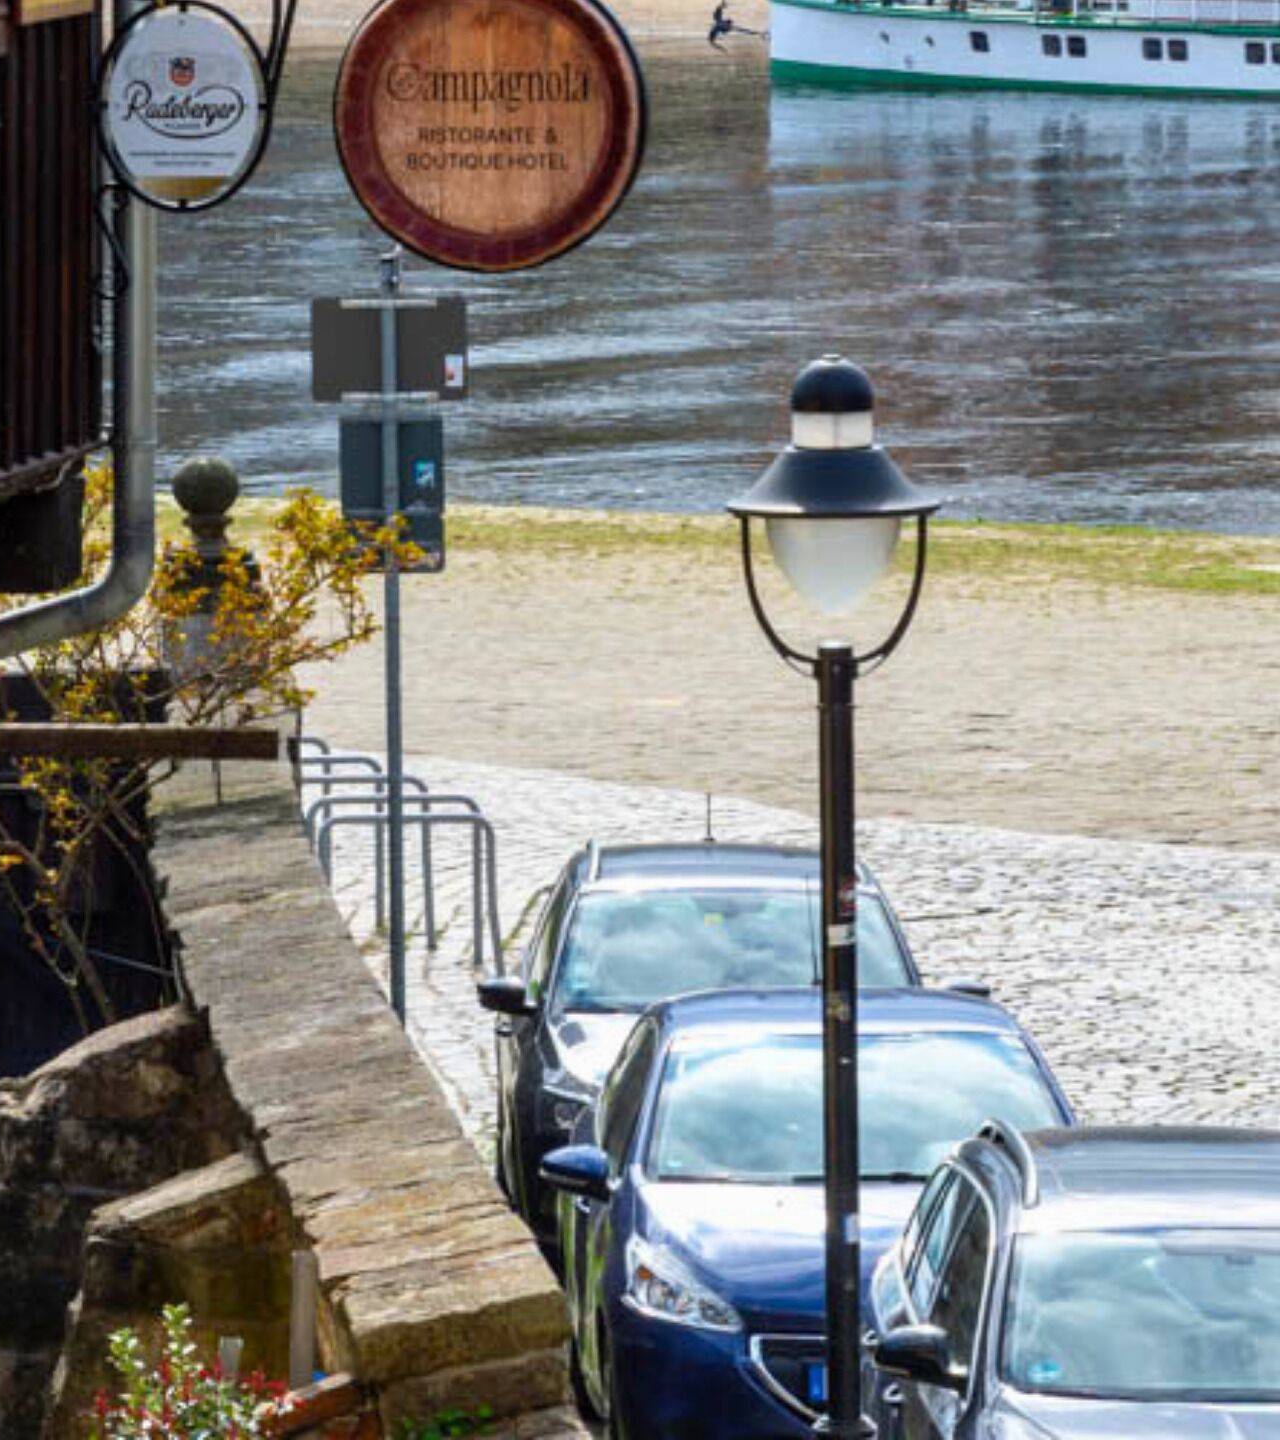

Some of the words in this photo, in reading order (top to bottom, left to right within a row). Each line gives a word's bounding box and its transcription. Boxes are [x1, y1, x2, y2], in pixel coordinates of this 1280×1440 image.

[122, 81, 242, 131] Radeberger
[387, 63, 591, 113] Campagnola
[418, 126, 536, 145] RISTORANTE
[545, 127, 559, 145] &
